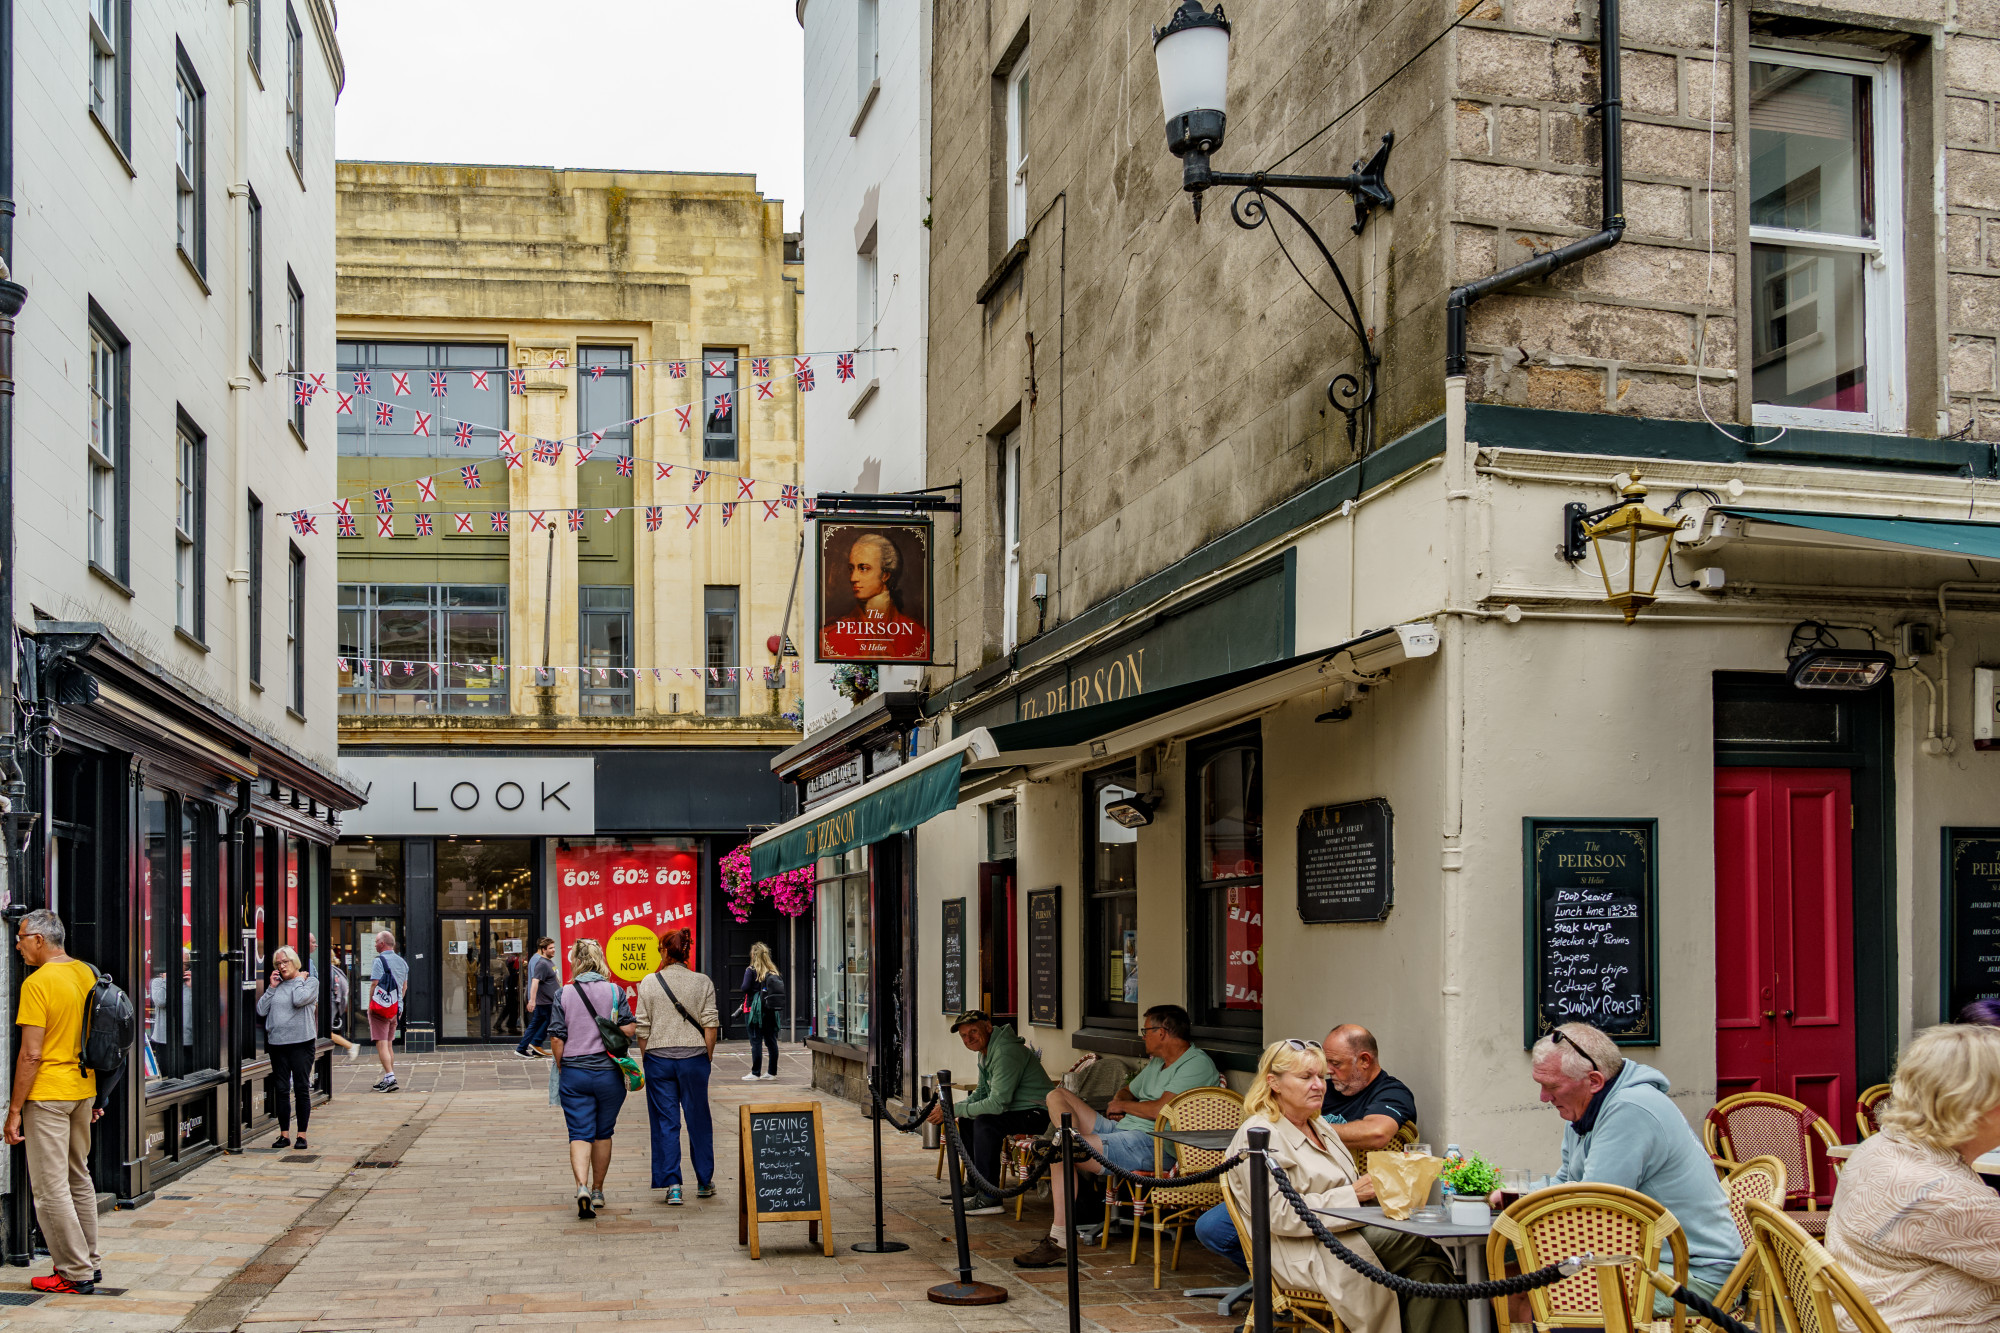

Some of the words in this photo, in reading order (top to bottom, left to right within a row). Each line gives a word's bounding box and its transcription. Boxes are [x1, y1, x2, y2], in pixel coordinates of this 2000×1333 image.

[867, 609, 884, 619] The
[836, 622, 914, 635] PEIRSON
[1046, 648, 1144, 714] PEIRSON
[414, 781, 570, 811] LOOK
[1317, 828, 1334, 837] BATTLE
[1346, 824, 1364, 833] JERSEY
[1585, 842, 1600, 851] The
[1558, 855, 1626, 867] PEIRSON
[564, 871, 600, 886] 60%
[613, 869, 648, 884] 60%
[656, 870, 691, 885] 60%
[565, 903, 604, 928] SALE
[613, 901, 652, 926] SALE
[1555, 906, 1582, 917] Lunch
[1586, 906, 1604, 916] time
[1555, 923, 1579, 933] Steak
[622, 943, 646, 951] NEW
[1588, 932, 1599, 948] of
[622, 953, 646, 961] SALE
[1554, 965, 1576, 977] Fish
[1580, 963, 1597, 975] and
[1601, 964, 1628, 979] chips
[1554, 979, 1596, 1000] Cottage
[1602, 976, 1615, 993] Pie
[377, 989, 390, 1003] FILA
[1603, 994, 1640, 1014] ROAST
[753, 1117, 808, 1131] EVENING
[766, 1131, 808, 1144] MEALS
[762, 1171, 803, 1185] Thursday
[759, 1187, 782, 1197] Come
[786, 1183, 804, 1194] and
